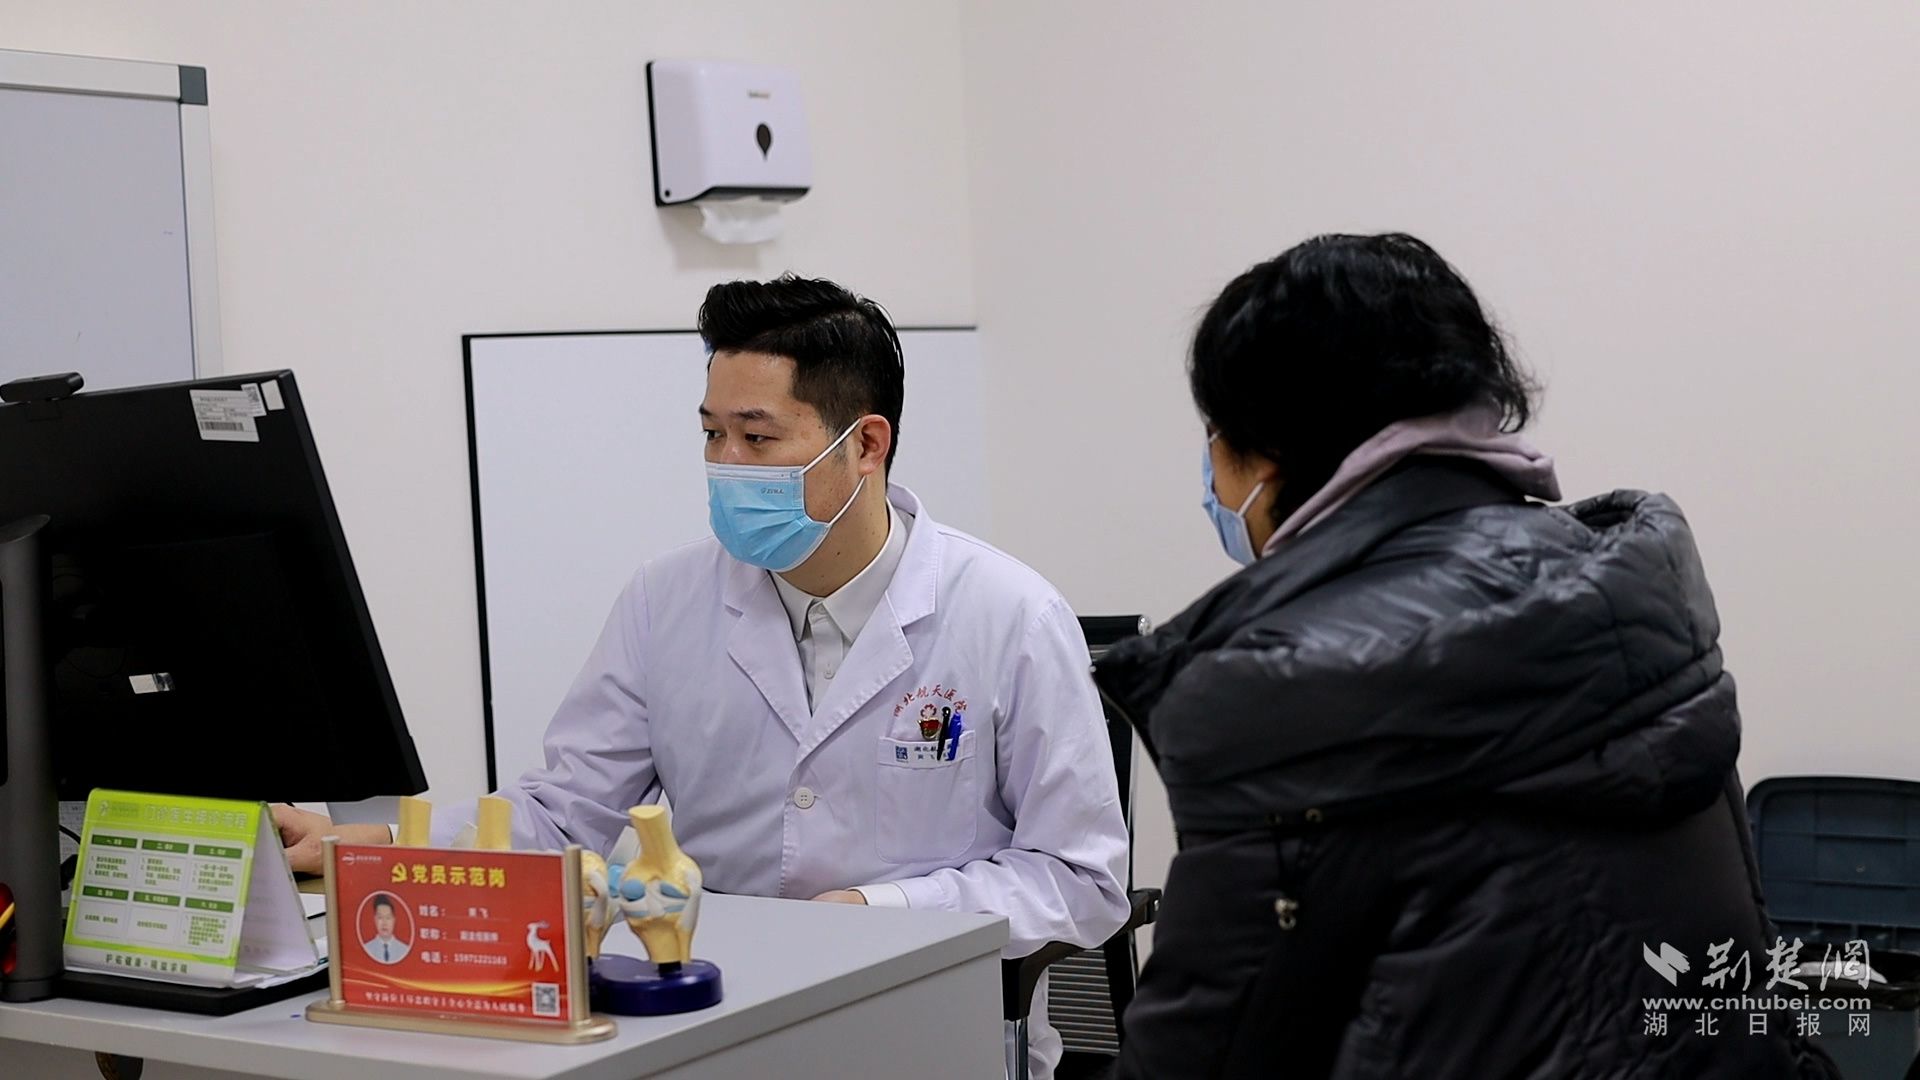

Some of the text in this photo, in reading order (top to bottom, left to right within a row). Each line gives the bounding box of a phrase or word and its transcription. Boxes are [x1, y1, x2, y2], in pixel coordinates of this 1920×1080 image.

[411, 863, 507, 888] 党员示范岗
